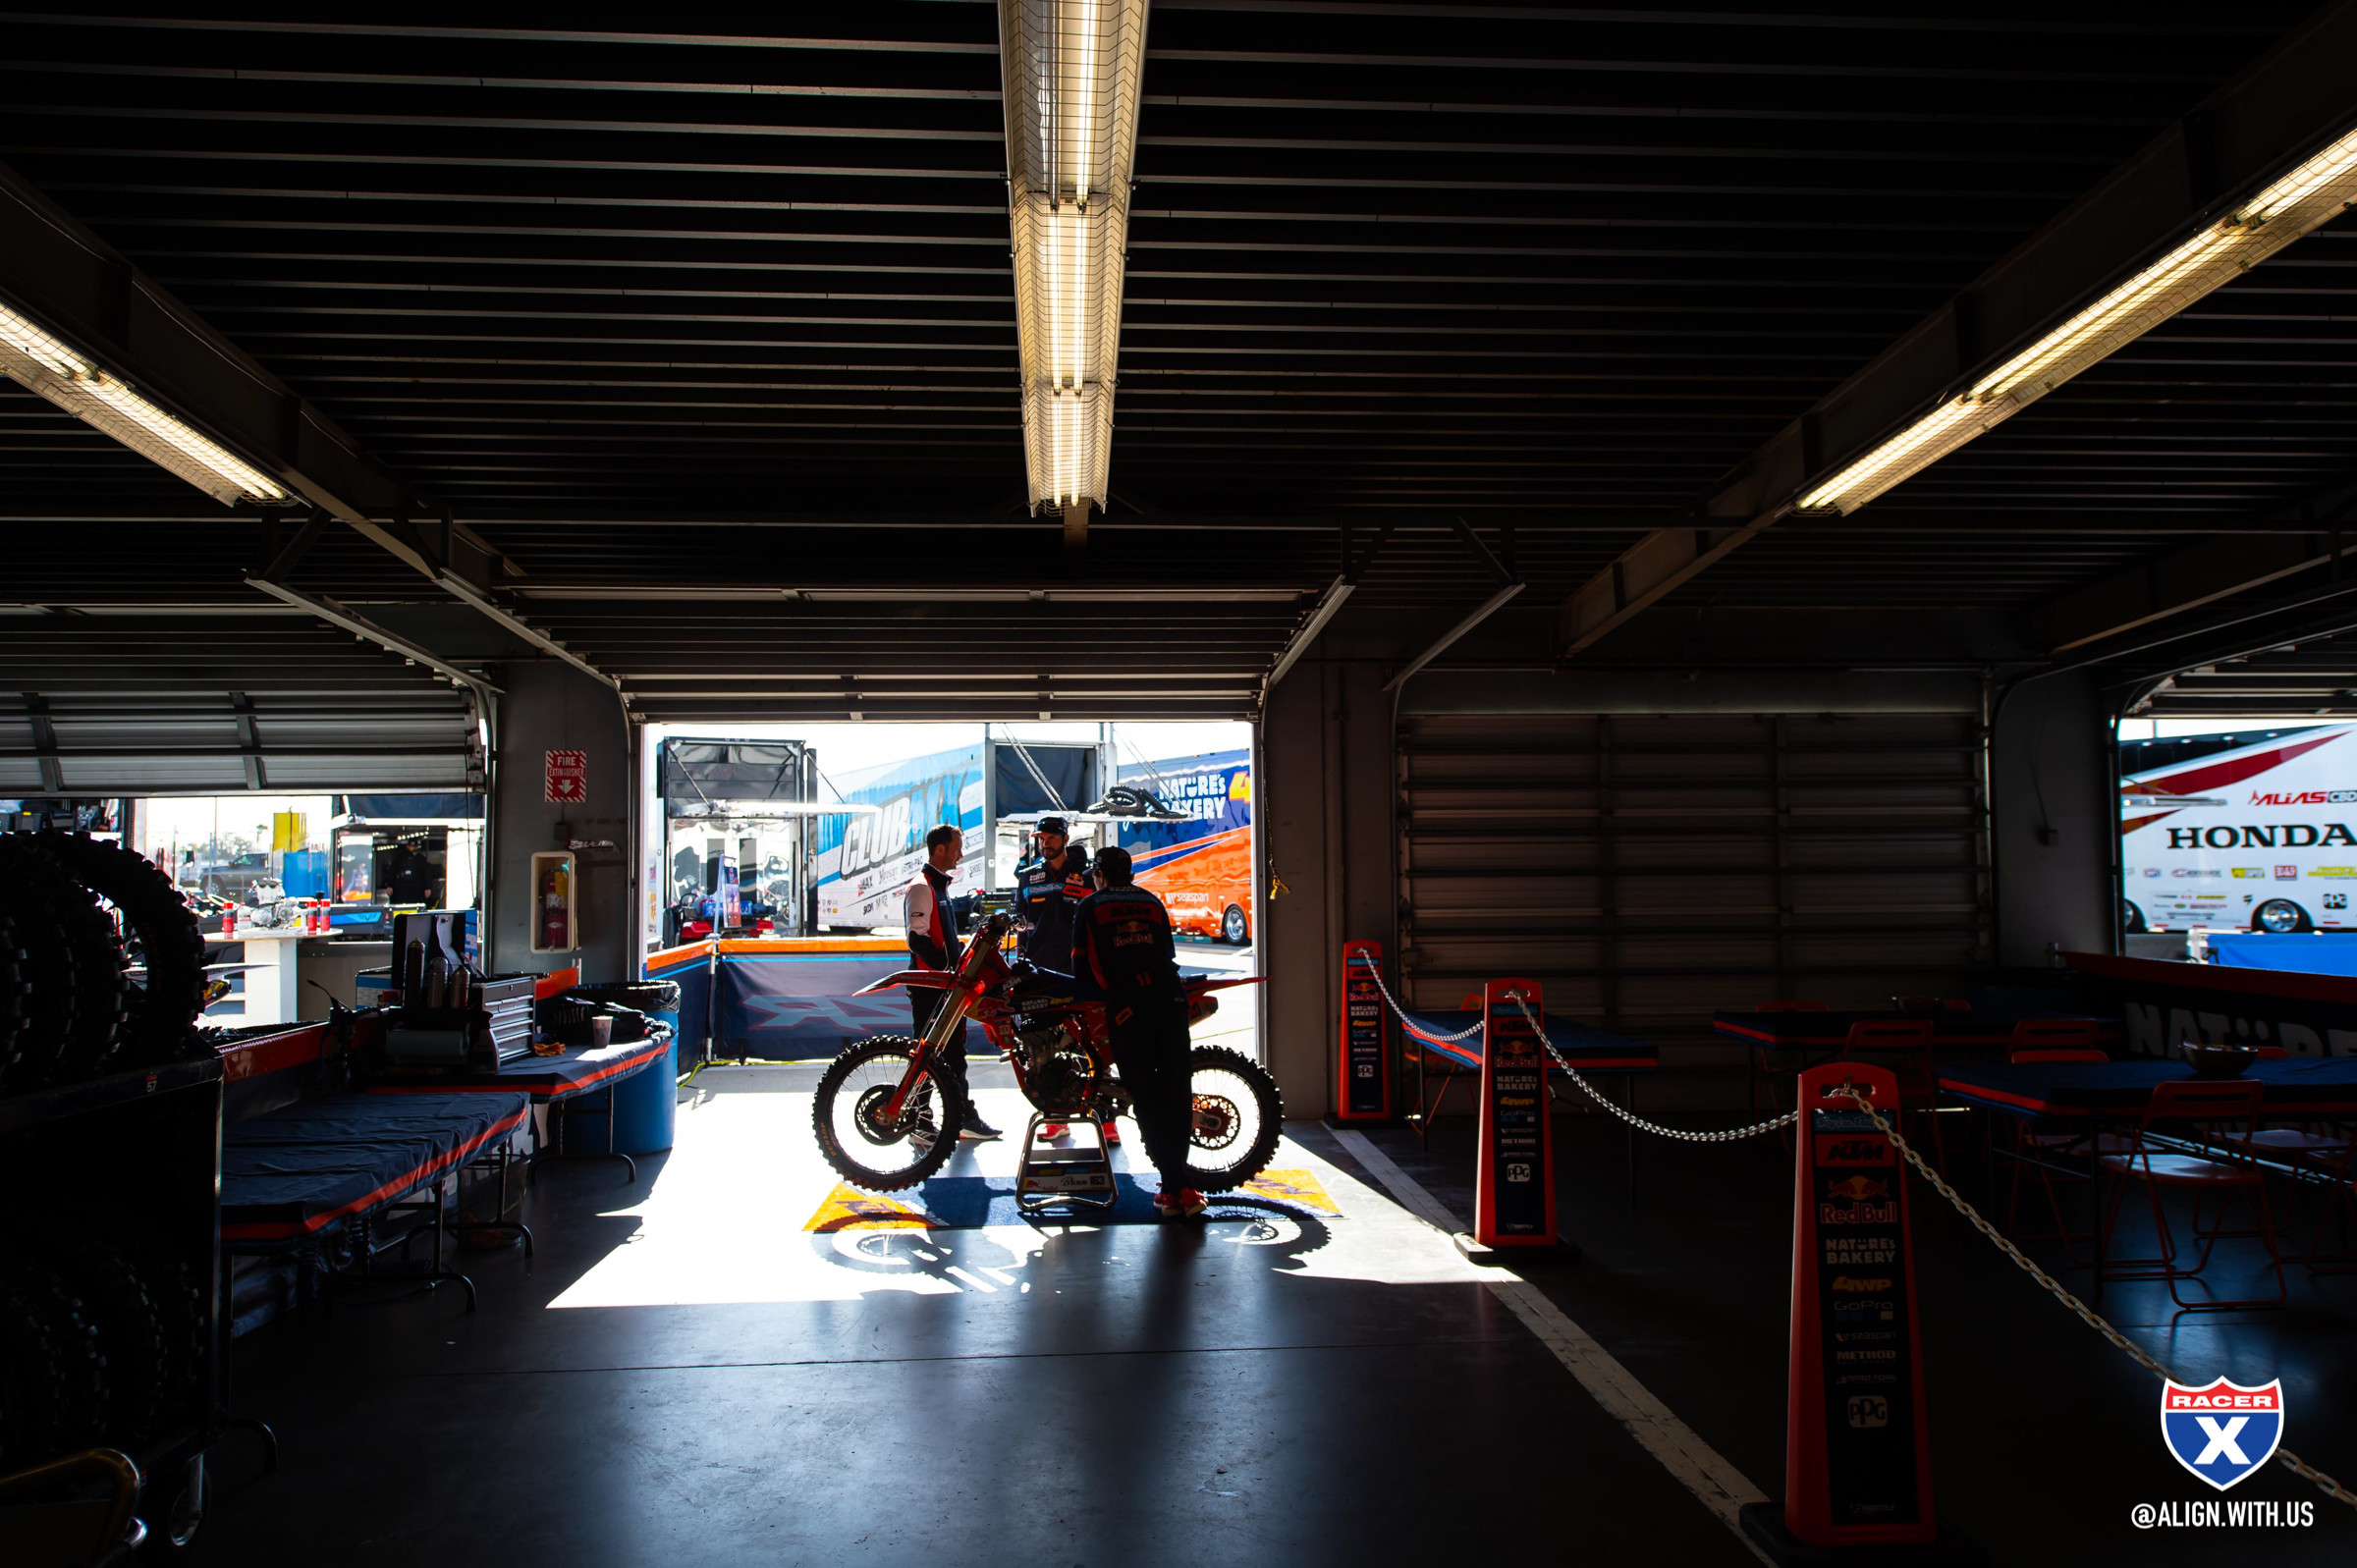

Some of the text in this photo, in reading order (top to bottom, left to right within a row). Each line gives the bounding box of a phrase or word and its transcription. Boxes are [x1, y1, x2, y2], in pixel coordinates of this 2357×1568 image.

[557, 756, 576, 766] FIRE
[549, 768, 585, 777] EXTINGUISHER
[2166, 823, 2357, 849] HONDA
[1177, 892, 1209, 903] seaspan
[1494, 1054, 1539, 1068] Red Bull
[146, 1079, 157, 1093] 57
[1828, 1140, 1885, 1161] KTM
[1507, 1164, 1529, 1180] PPG
[1090, 1175, 1105, 1185] 163
[1819, 1201, 1898, 1224] Red Bull
[1826, 1250, 1896, 1265] BAKERY
[1833, 1300, 1893, 1311] GoPro
[1851, 1331, 1897, 1342] seaspan
[1836, 1350, 1897, 1360] METHOD
[1850, 1398, 1886, 1426] PPG
